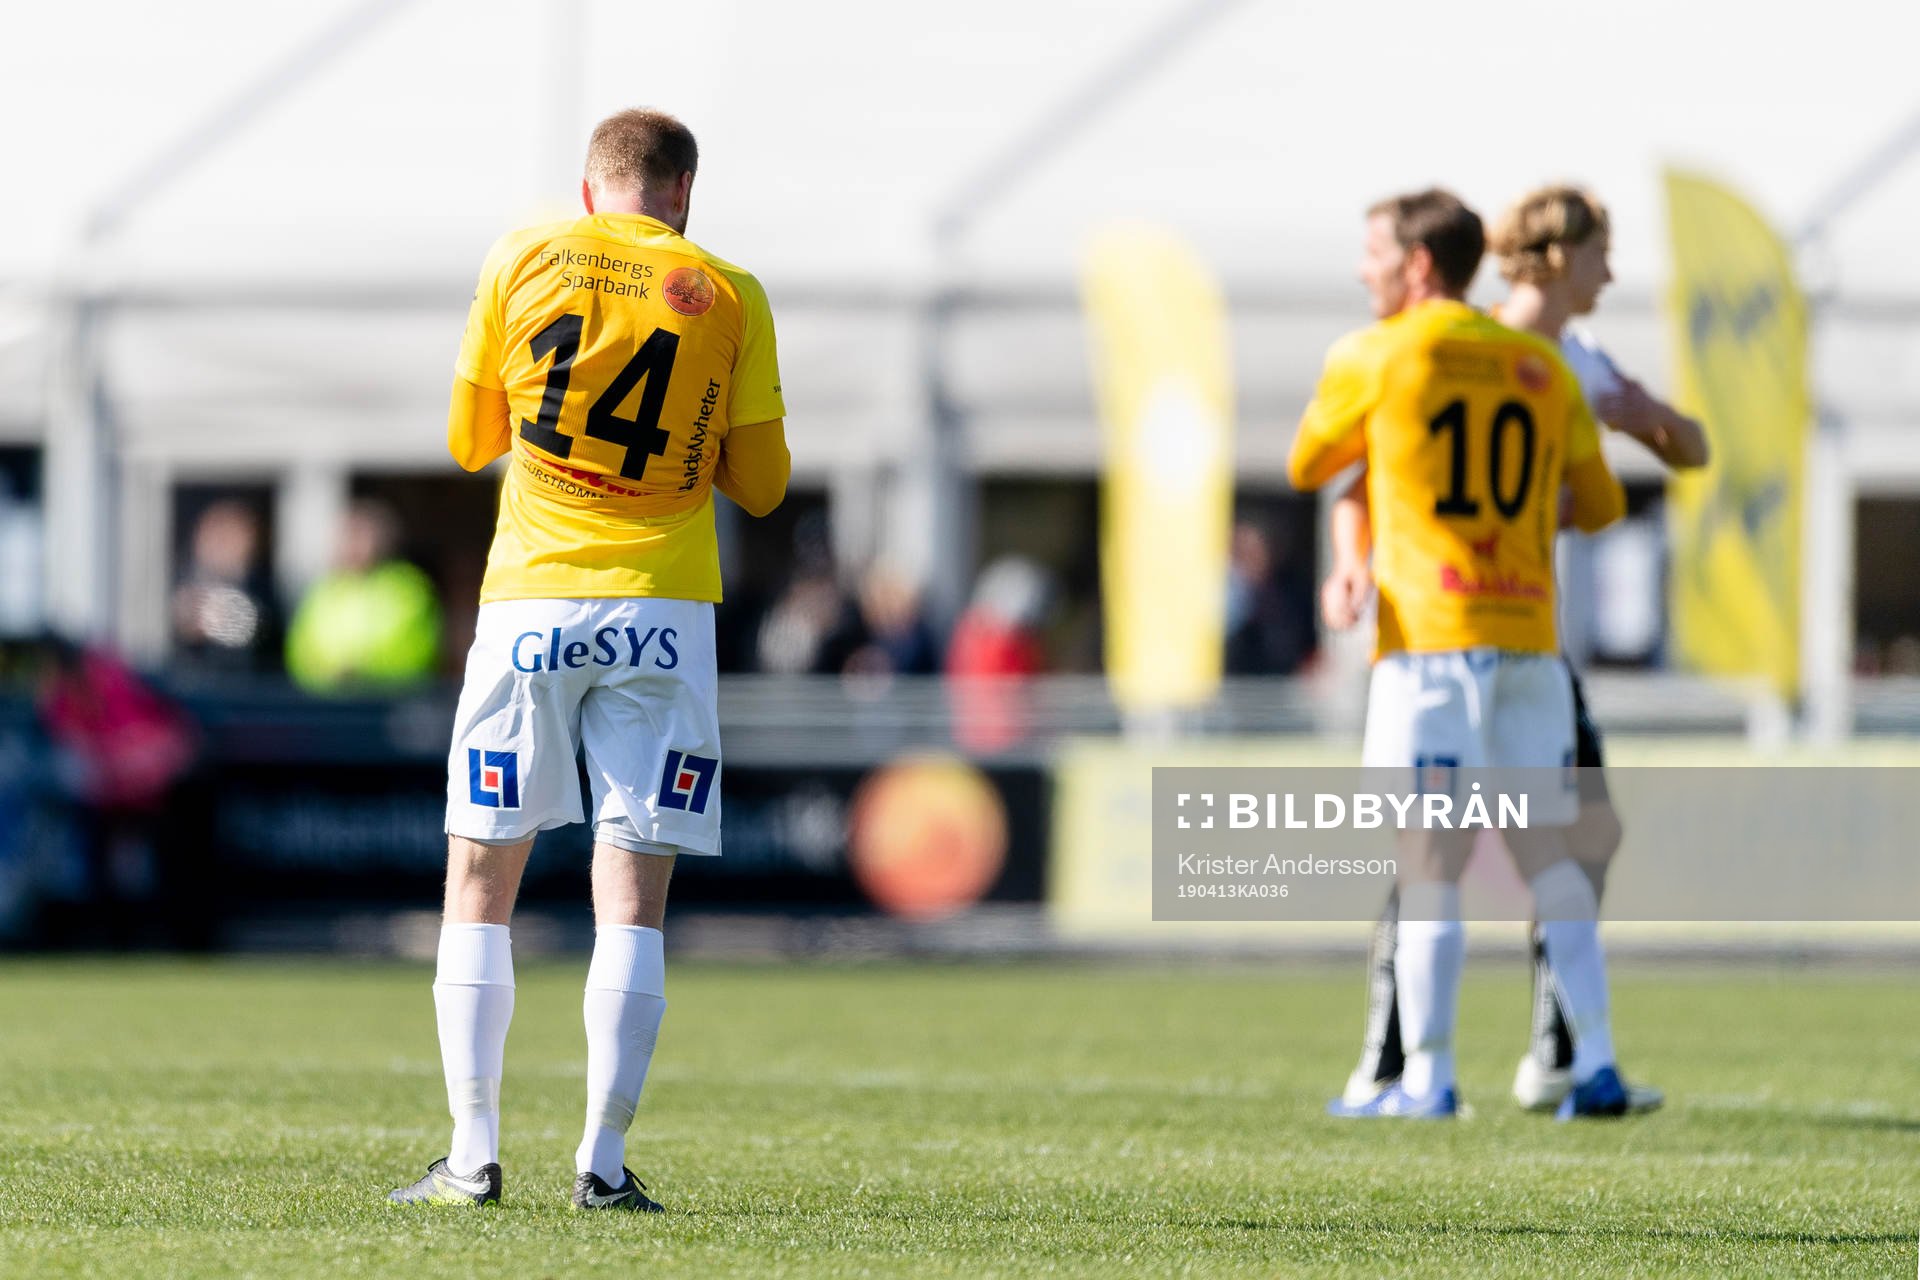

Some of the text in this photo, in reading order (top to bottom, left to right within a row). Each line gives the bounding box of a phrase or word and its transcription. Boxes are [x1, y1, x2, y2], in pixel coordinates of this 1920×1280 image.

[540, 249, 654, 279] Falkenbergs
[560, 271, 651, 299] Sparbank
[520, 313, 680, 481] 14
[1429, 399, 1535, 519] 10
[512, 627, 679, 673] GleSYS
